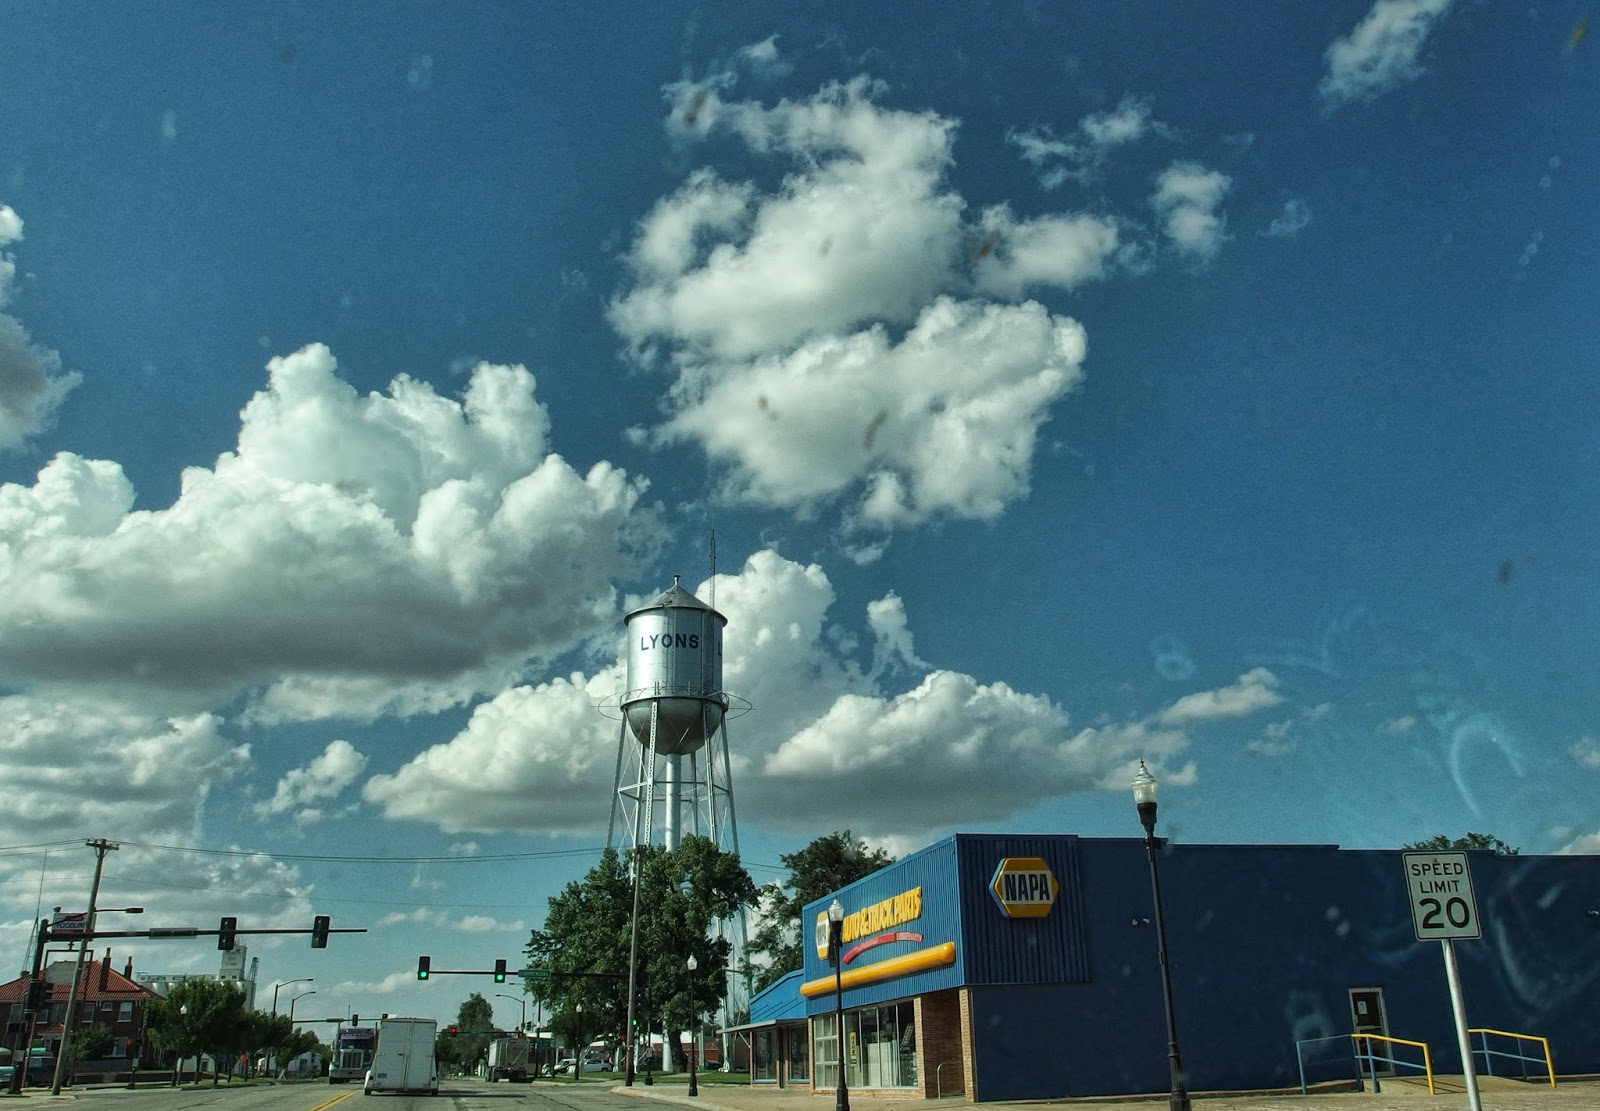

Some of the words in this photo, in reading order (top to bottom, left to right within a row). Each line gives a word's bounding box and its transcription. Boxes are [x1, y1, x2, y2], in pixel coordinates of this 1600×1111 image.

[641, 633, 699, 651] LYONS
[1411, 863, 1464, 876] SPEED
[1004, 873, 1051, 901] NAPA
[1420, 880, 1460, 894] LIMIT
[893, 886, 922, 925] PARTS
[1418, 897, 1470, 929] 20
